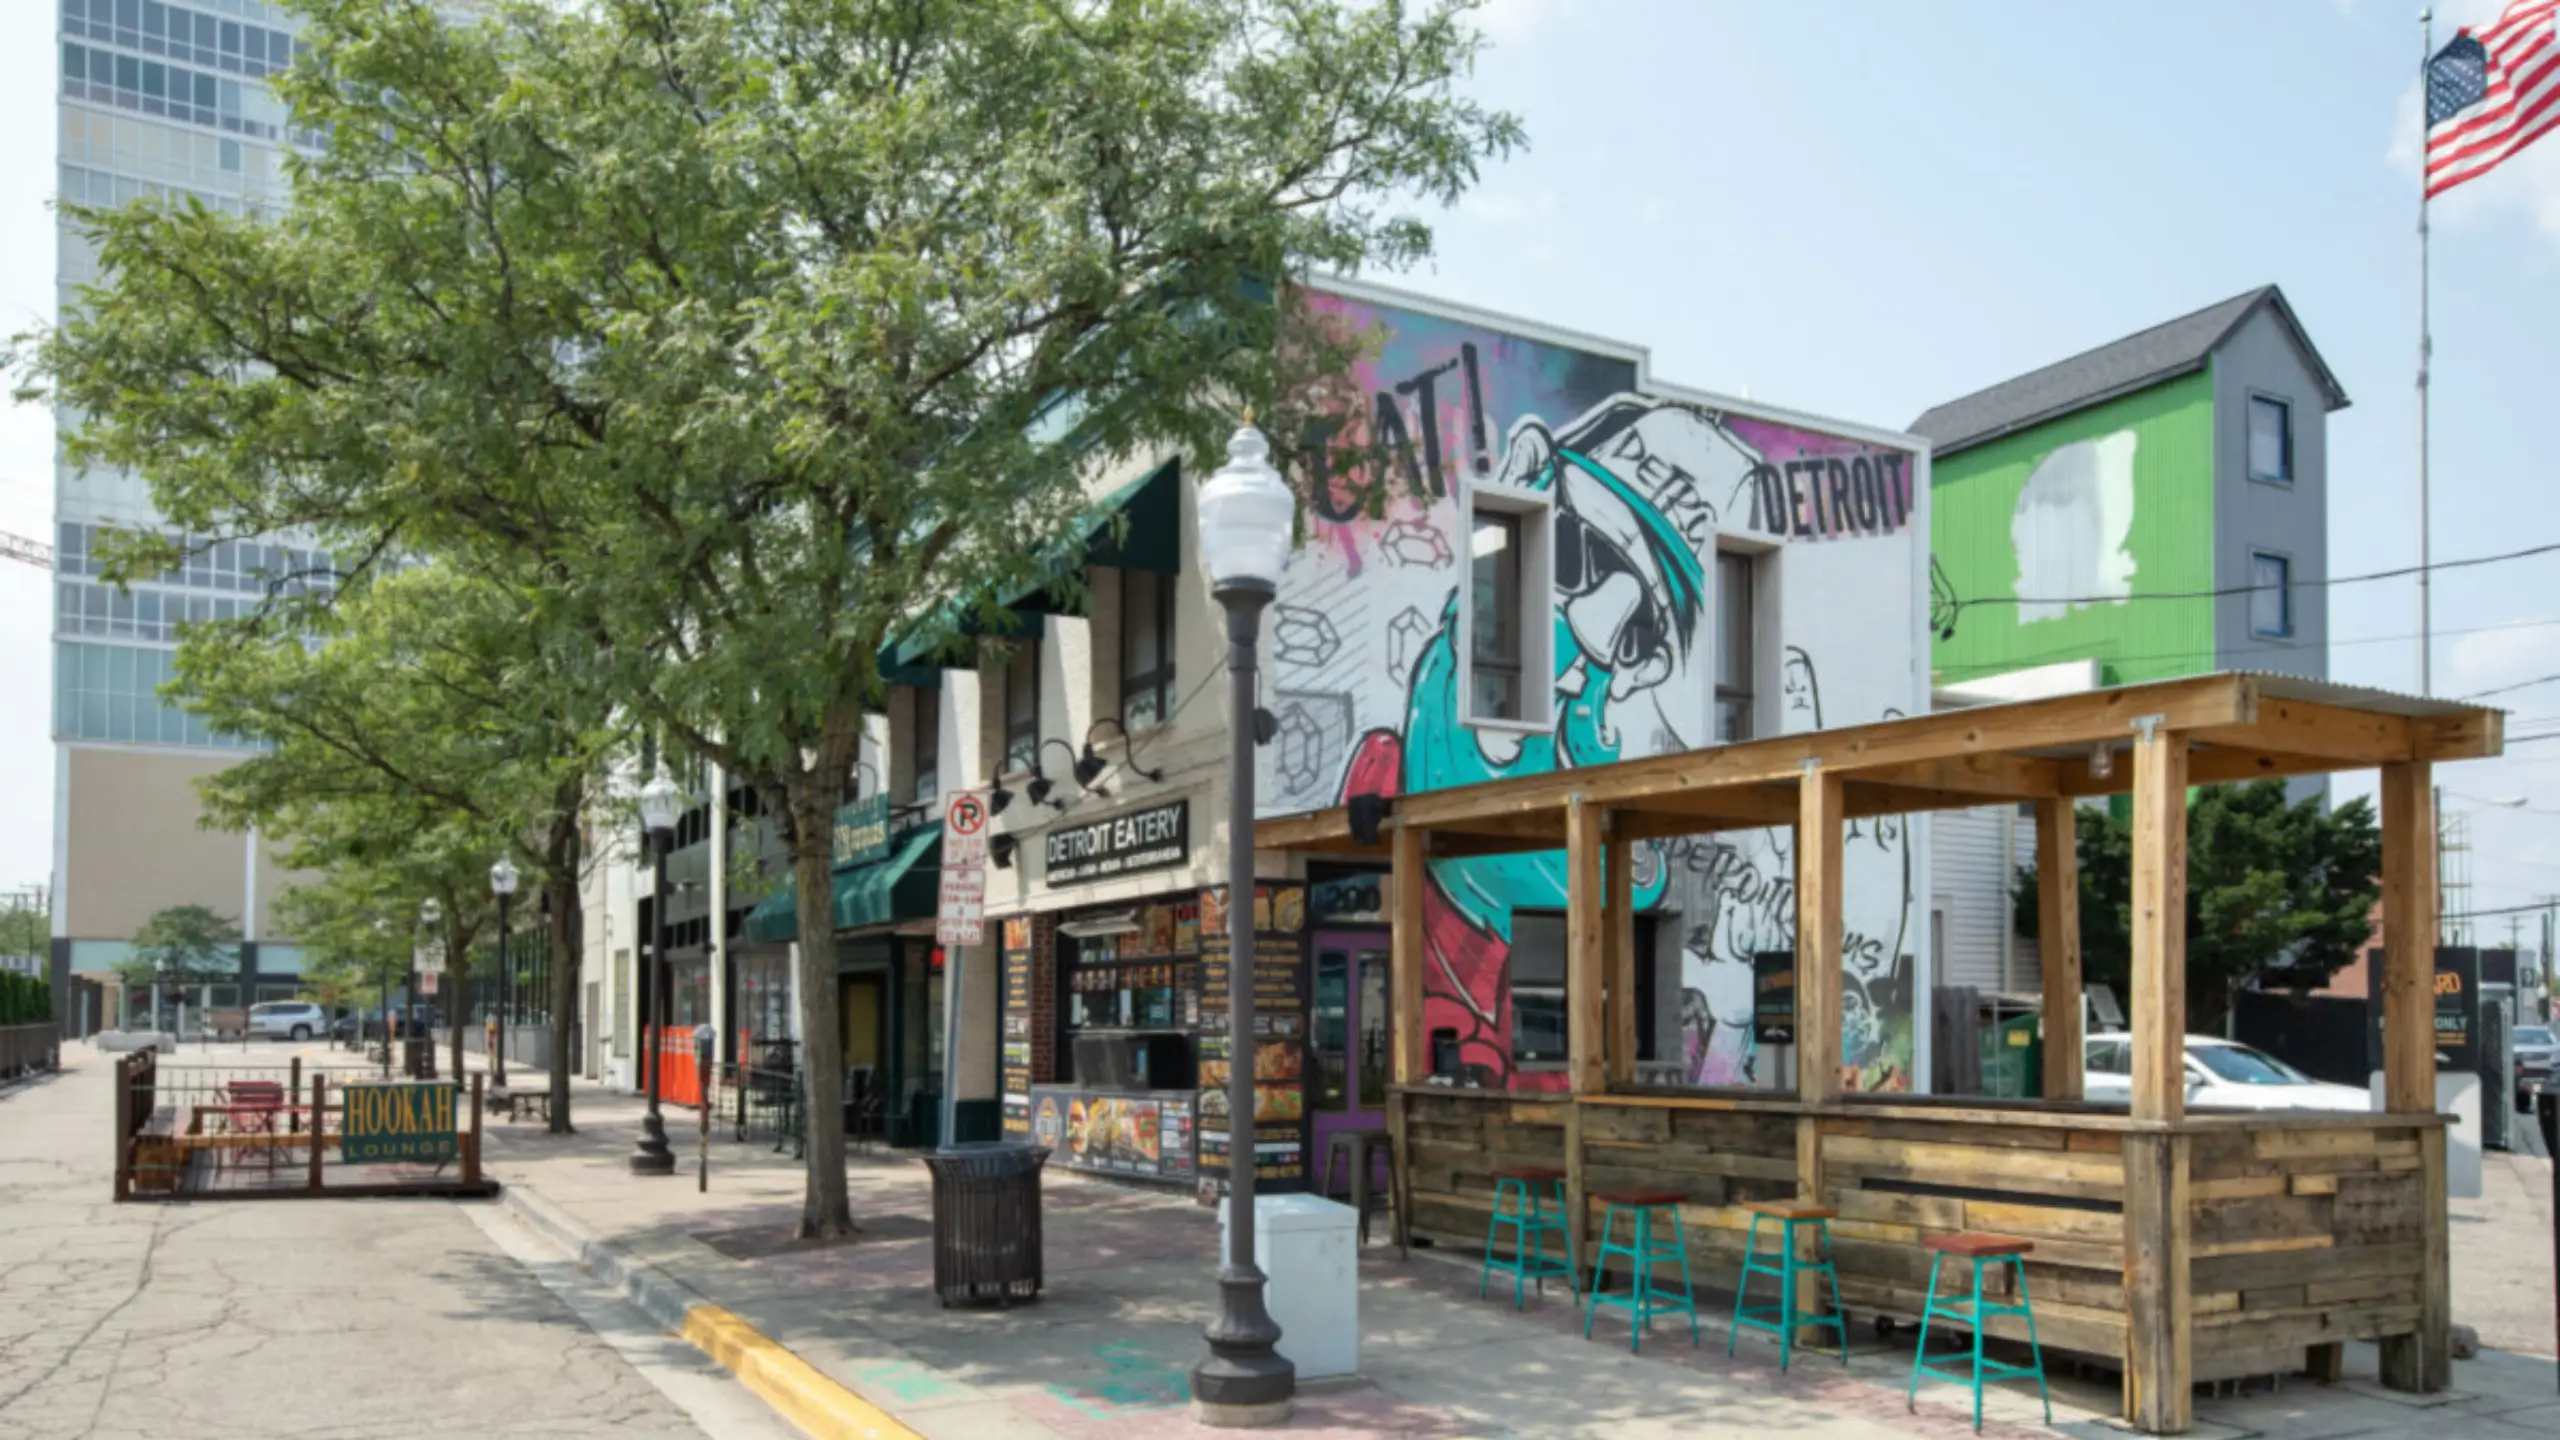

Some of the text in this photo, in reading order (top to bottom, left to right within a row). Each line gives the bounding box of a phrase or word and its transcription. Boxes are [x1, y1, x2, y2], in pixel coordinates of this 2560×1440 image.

[1757, 453, 1907, 537] DETROIT
[1048, 822, 1112, 864] DETROIT
[1114, 804, 1181, 850] EATERY
[348, 1085, 453, 1136] HOOKAH
[348, 1141, 450, 1157] LOUNGE
